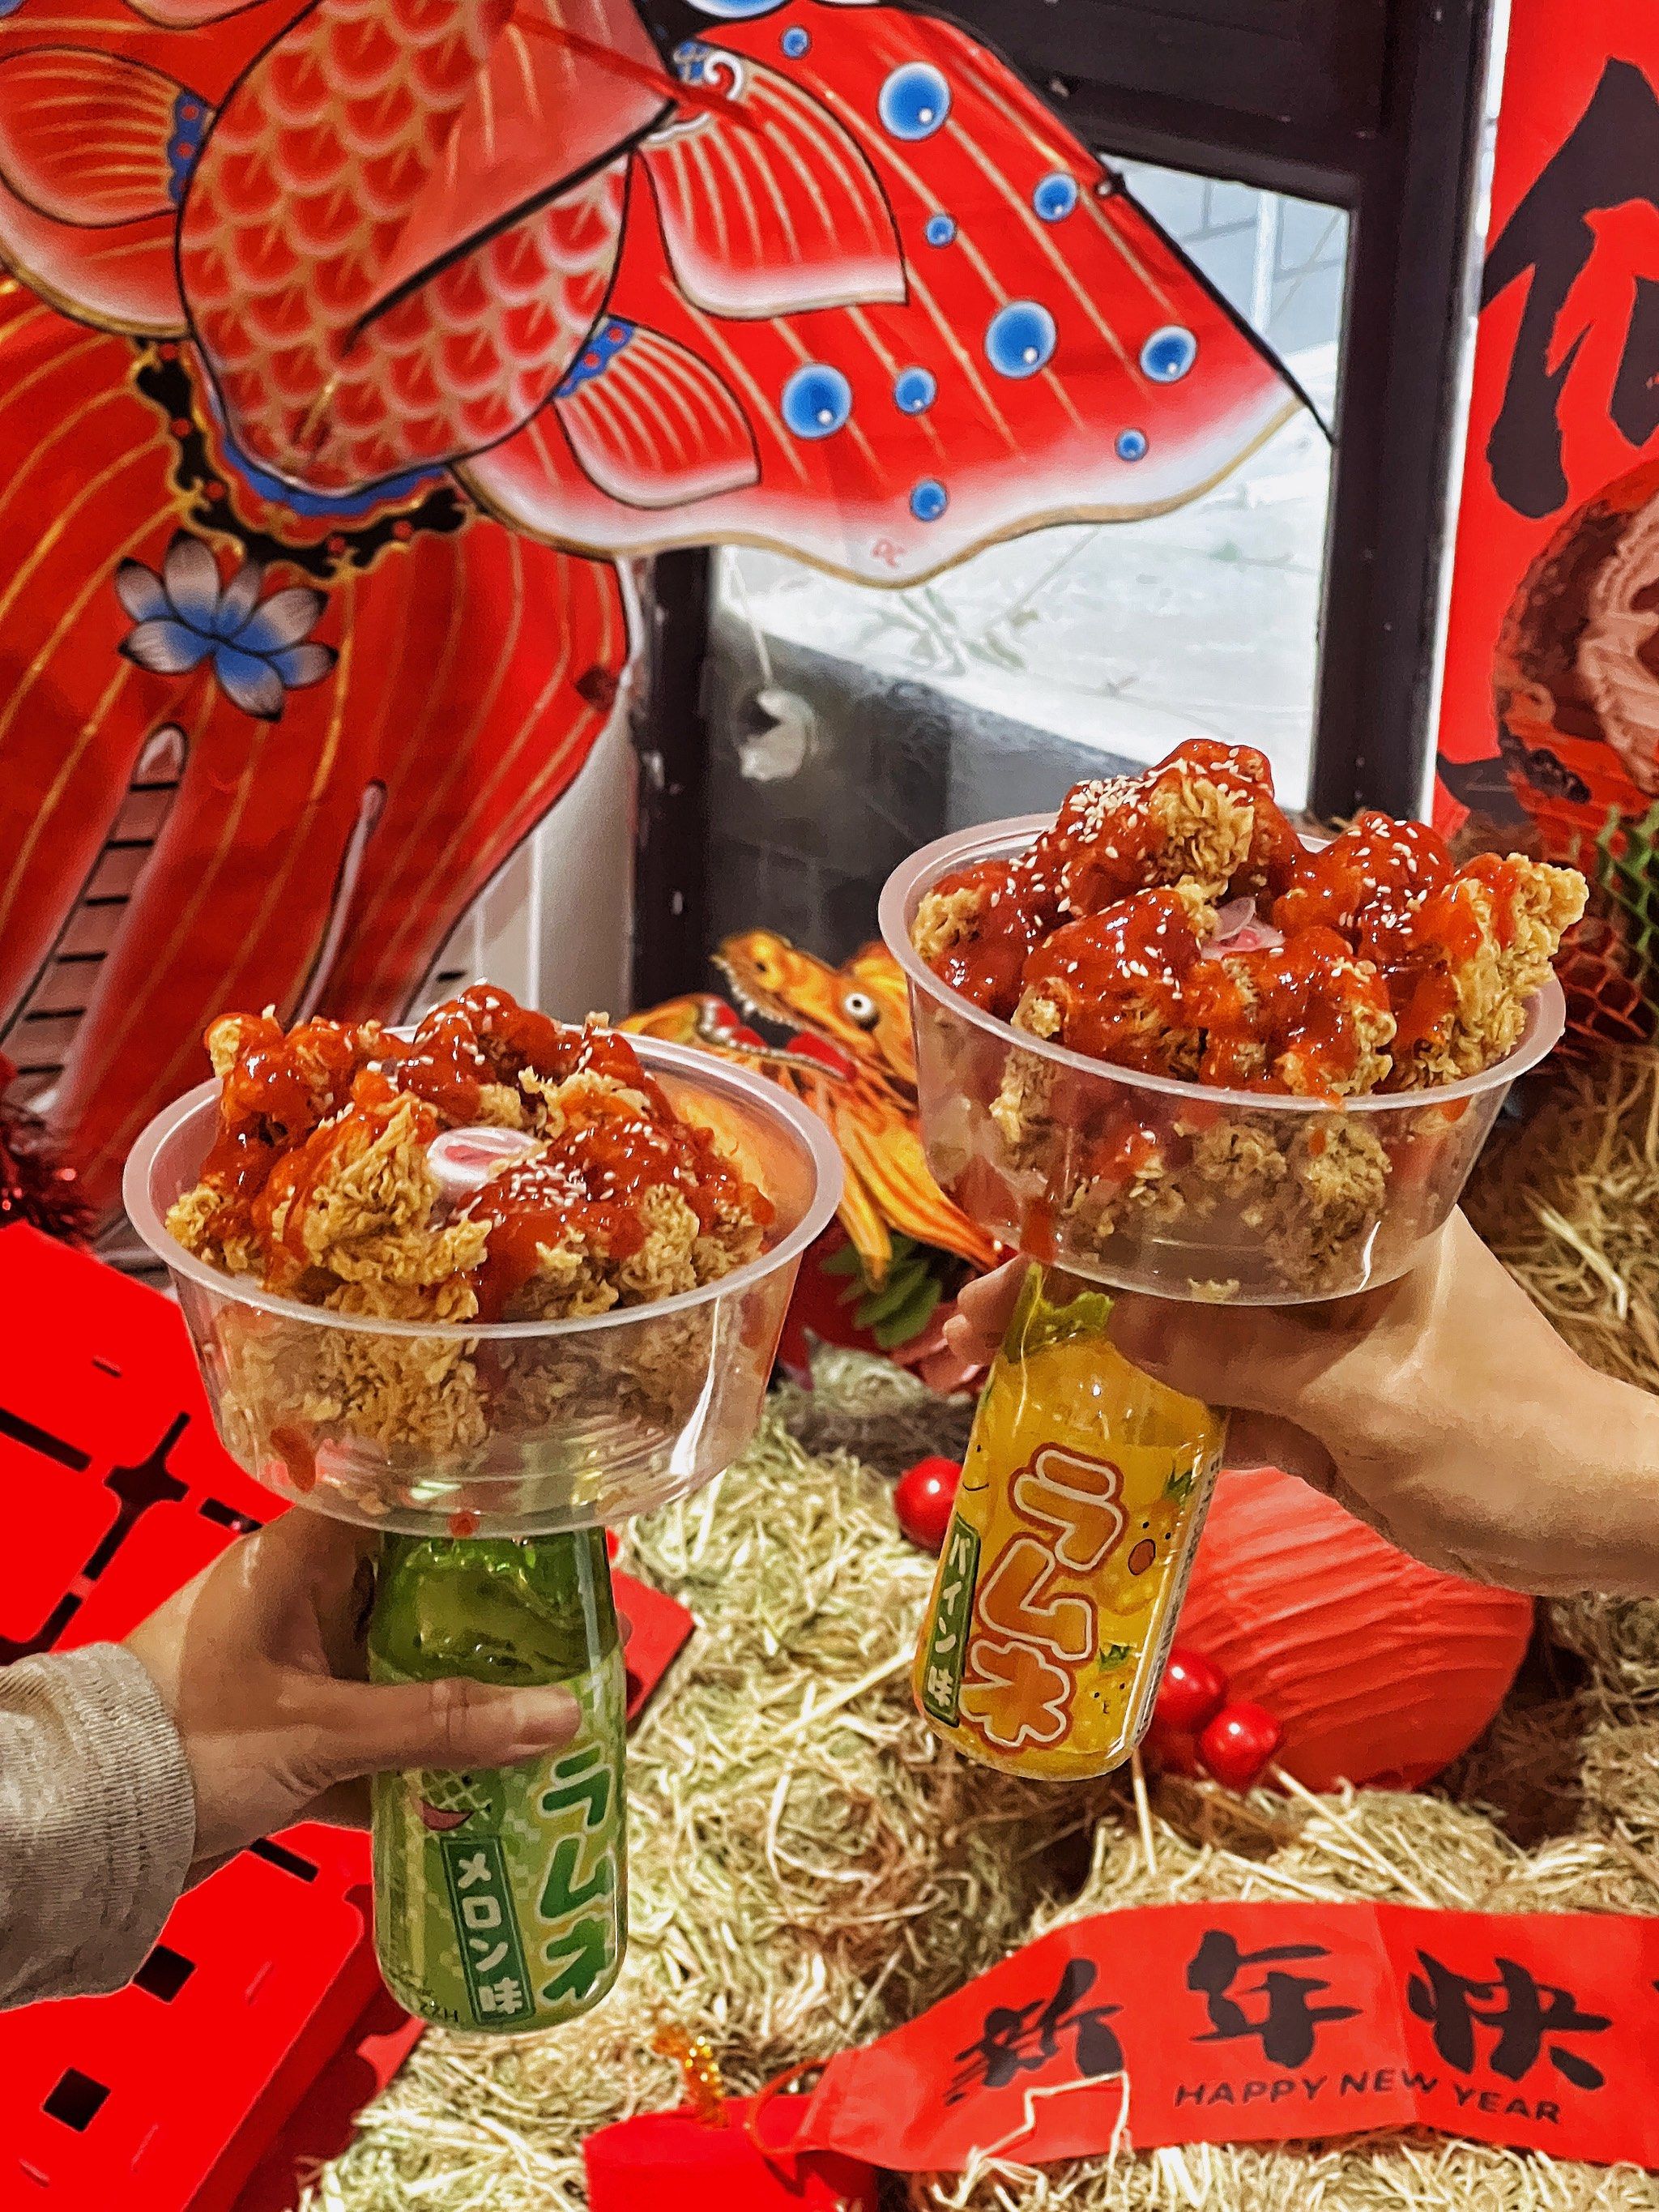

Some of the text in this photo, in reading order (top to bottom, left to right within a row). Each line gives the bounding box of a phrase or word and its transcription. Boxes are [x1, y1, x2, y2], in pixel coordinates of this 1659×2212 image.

[956, 1445, 1128, 1752] ラムネ
[458, 1851, 523, 2014] メロン味
[538, 1744, 616, 2005] ラムネ
[1174, 2068, 1561, 2124] HAPPY NEW YEAR
